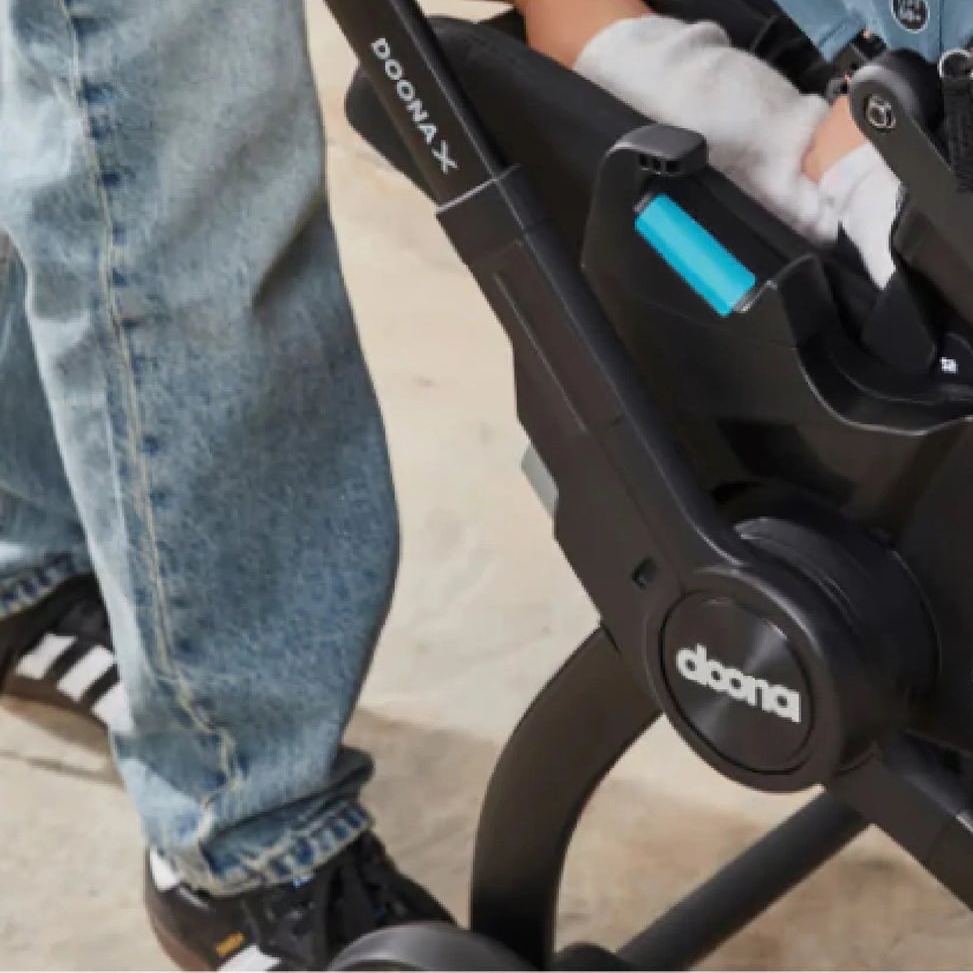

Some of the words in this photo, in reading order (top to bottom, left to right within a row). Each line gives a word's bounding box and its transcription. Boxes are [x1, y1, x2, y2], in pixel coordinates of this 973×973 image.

[370, 37, 437, 145] DOONA
[431, 139, 458, 174] X
[675, 643, 801, 723] doona
